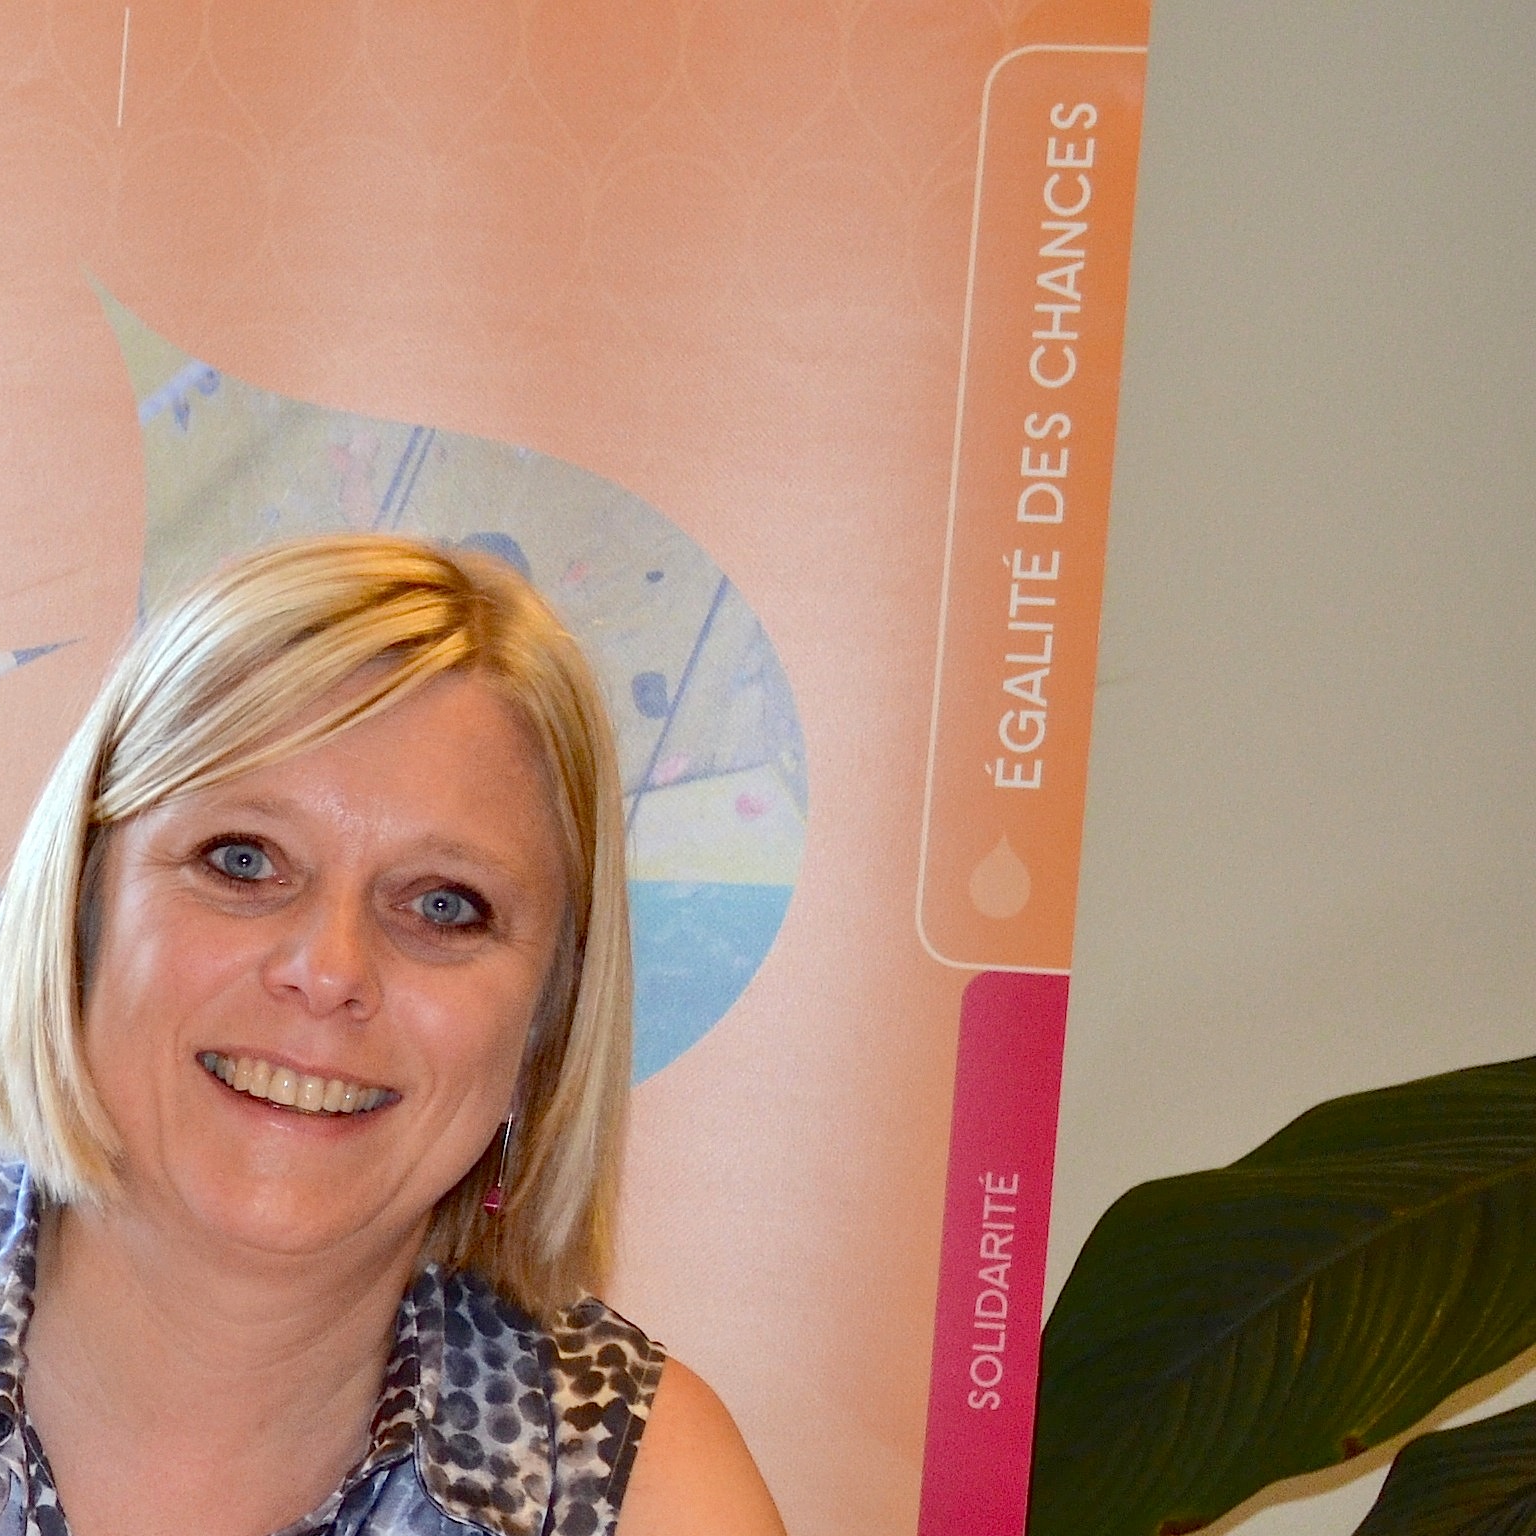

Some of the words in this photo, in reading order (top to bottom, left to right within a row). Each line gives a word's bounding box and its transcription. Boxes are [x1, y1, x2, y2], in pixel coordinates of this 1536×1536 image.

[1029, 102, 1098, 388] CHANCES
[1017, 412, 1072, 523] DES
[986, 549, 1062, 790] ÉGALITÉ
[967, 1172, 1019, 1410] SOLIDARITÉ
